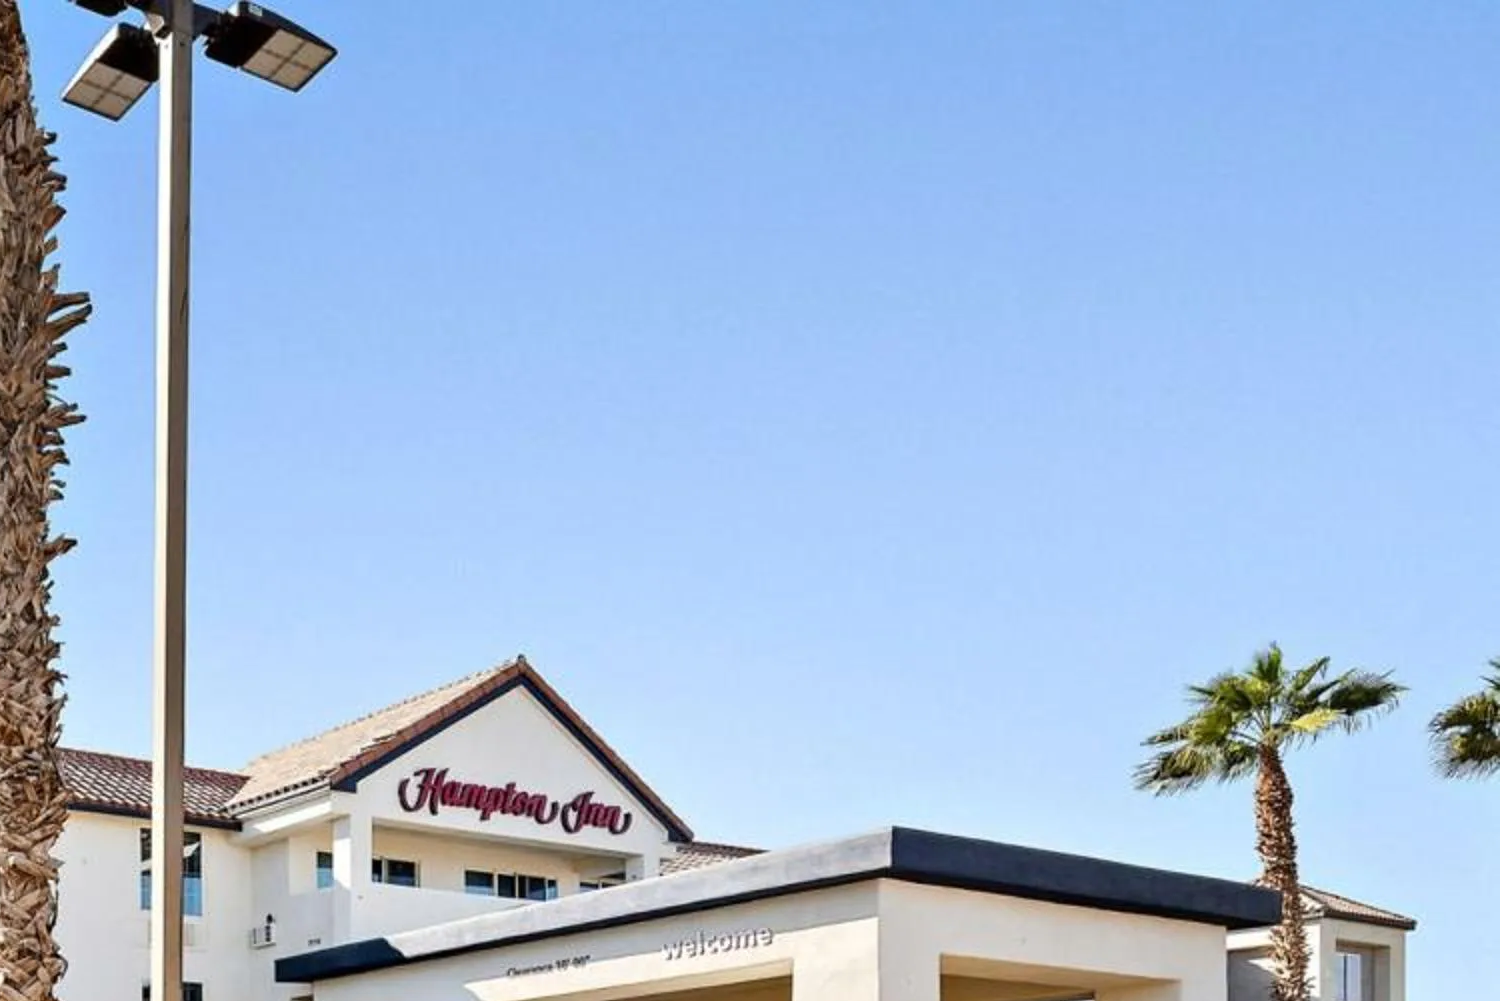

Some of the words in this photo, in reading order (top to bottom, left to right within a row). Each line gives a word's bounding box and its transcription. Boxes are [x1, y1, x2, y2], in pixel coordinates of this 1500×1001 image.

[397, 767, 559, 825] Hampton
[561, 791, 633, 835] Inn
[662, 927, 773, 961] welcome
